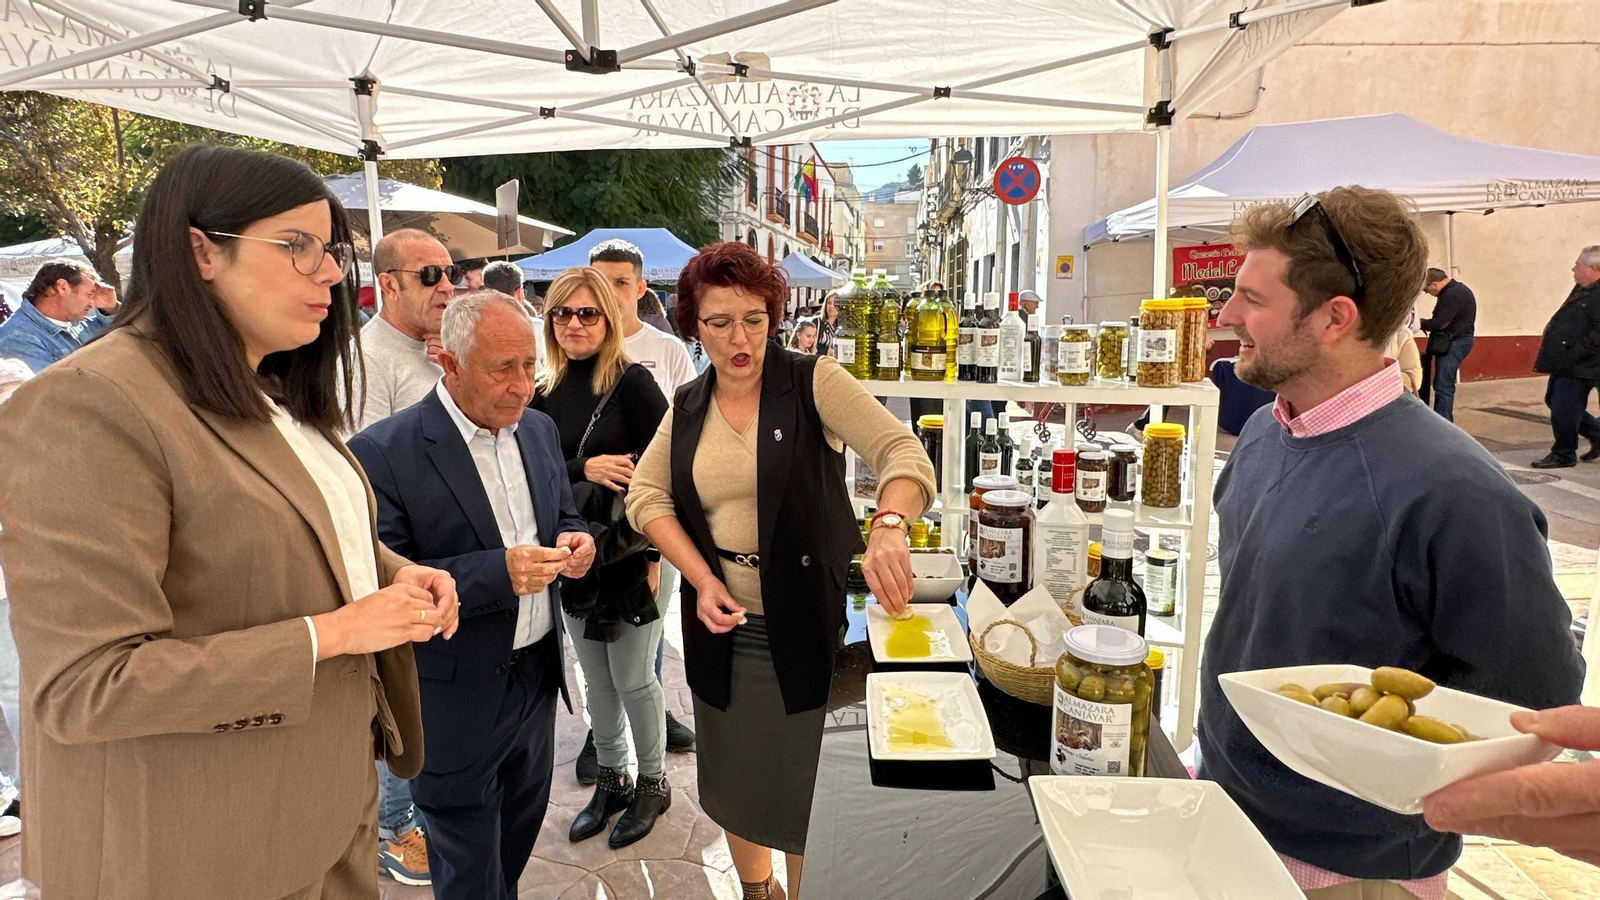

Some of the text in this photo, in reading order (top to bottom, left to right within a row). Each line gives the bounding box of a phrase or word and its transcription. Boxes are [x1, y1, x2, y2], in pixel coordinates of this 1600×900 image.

[1486, 182, 1501, 193] LA
[1486, 192, 1502, 202] DE
[1182, 261, 1224, 280] Medal
[1063, 695, 1115, 714] ALMAZARA
